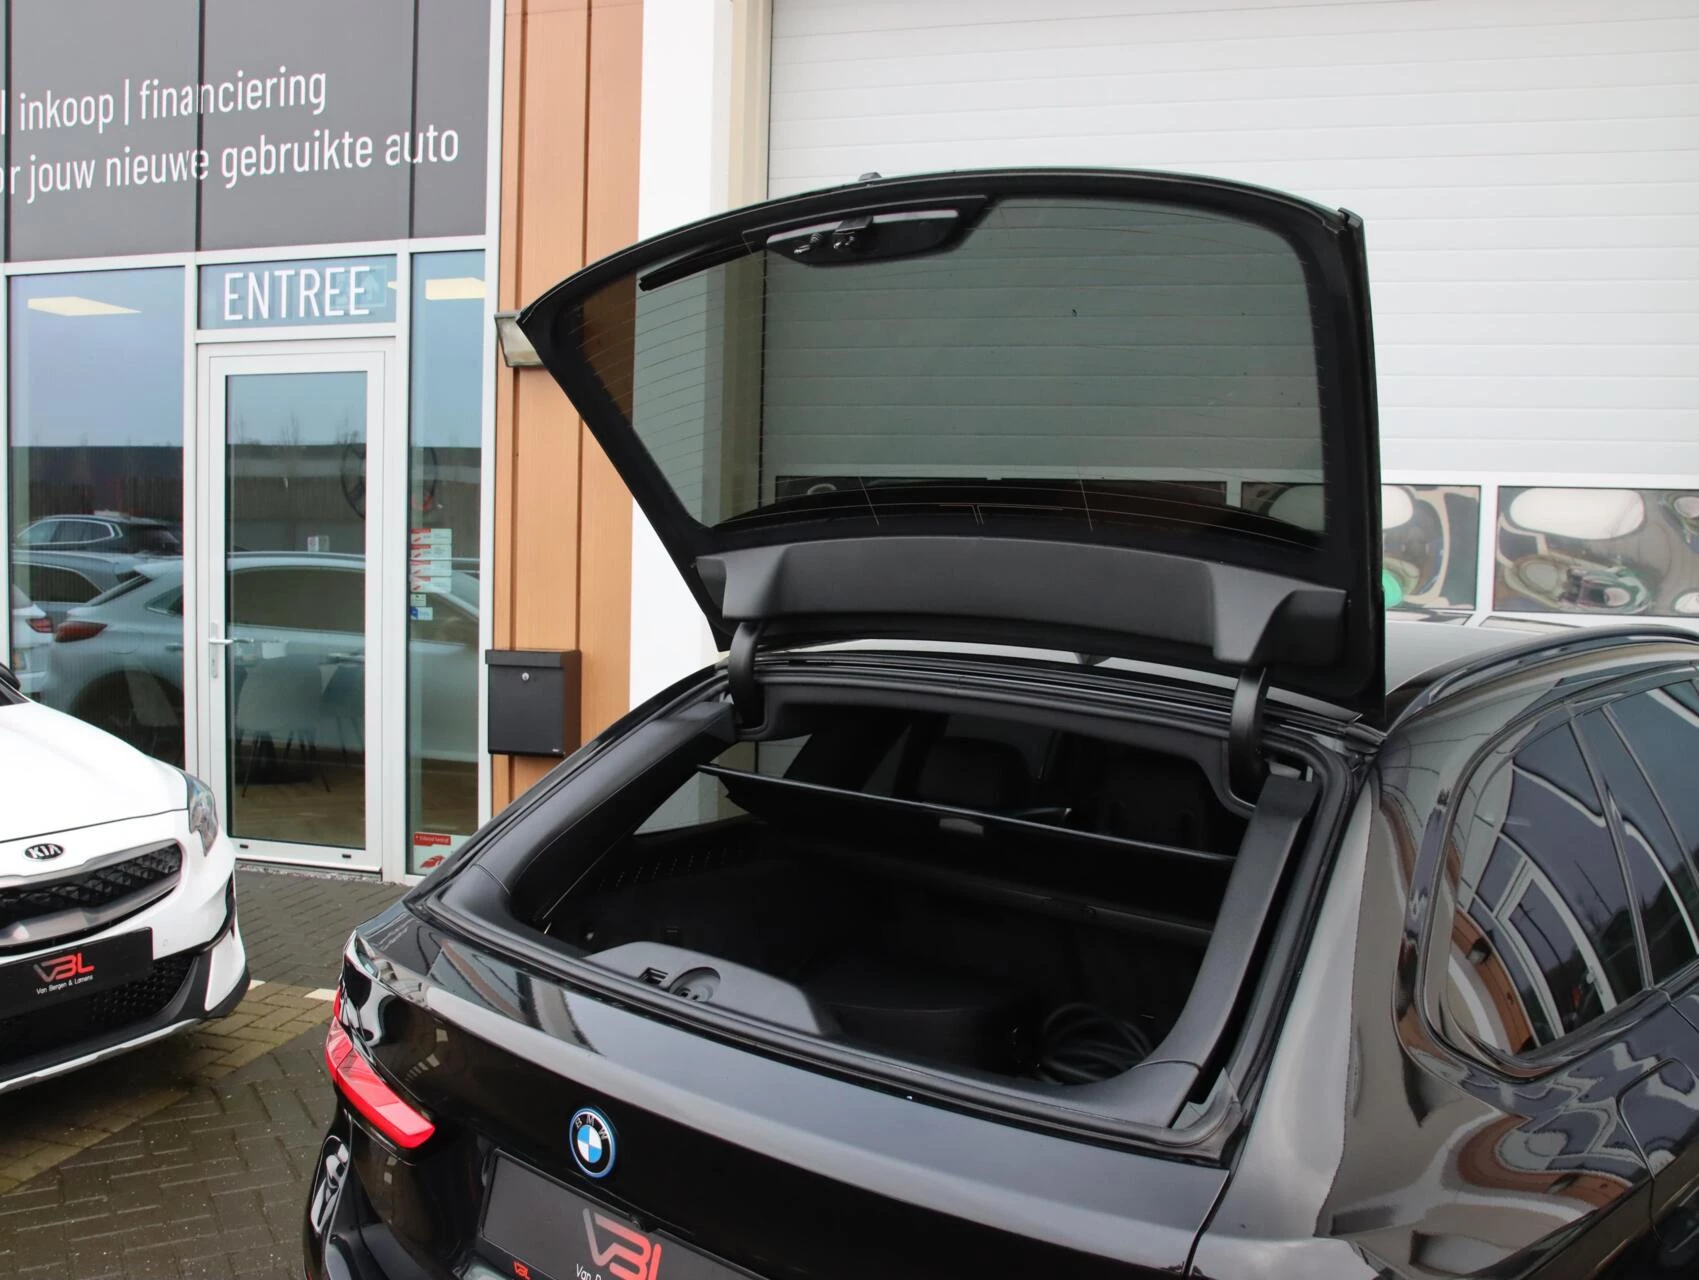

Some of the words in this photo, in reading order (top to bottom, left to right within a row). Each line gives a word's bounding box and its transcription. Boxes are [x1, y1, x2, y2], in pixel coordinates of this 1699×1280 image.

[19, 89, 115, 134] inkoop
[139, 65, 327, 120] financiering
[26, 154, 96, 205] jouw
[105, 146, 210, 188] nieuwe
[221, 128, 374, 190] gebruikte
[384, 123, 460, 168] auto
[223, 265, 371, 322] ENTREE
[28, 844, 62, 859] KIA
[575, 1113, 609, 1141] BMW
